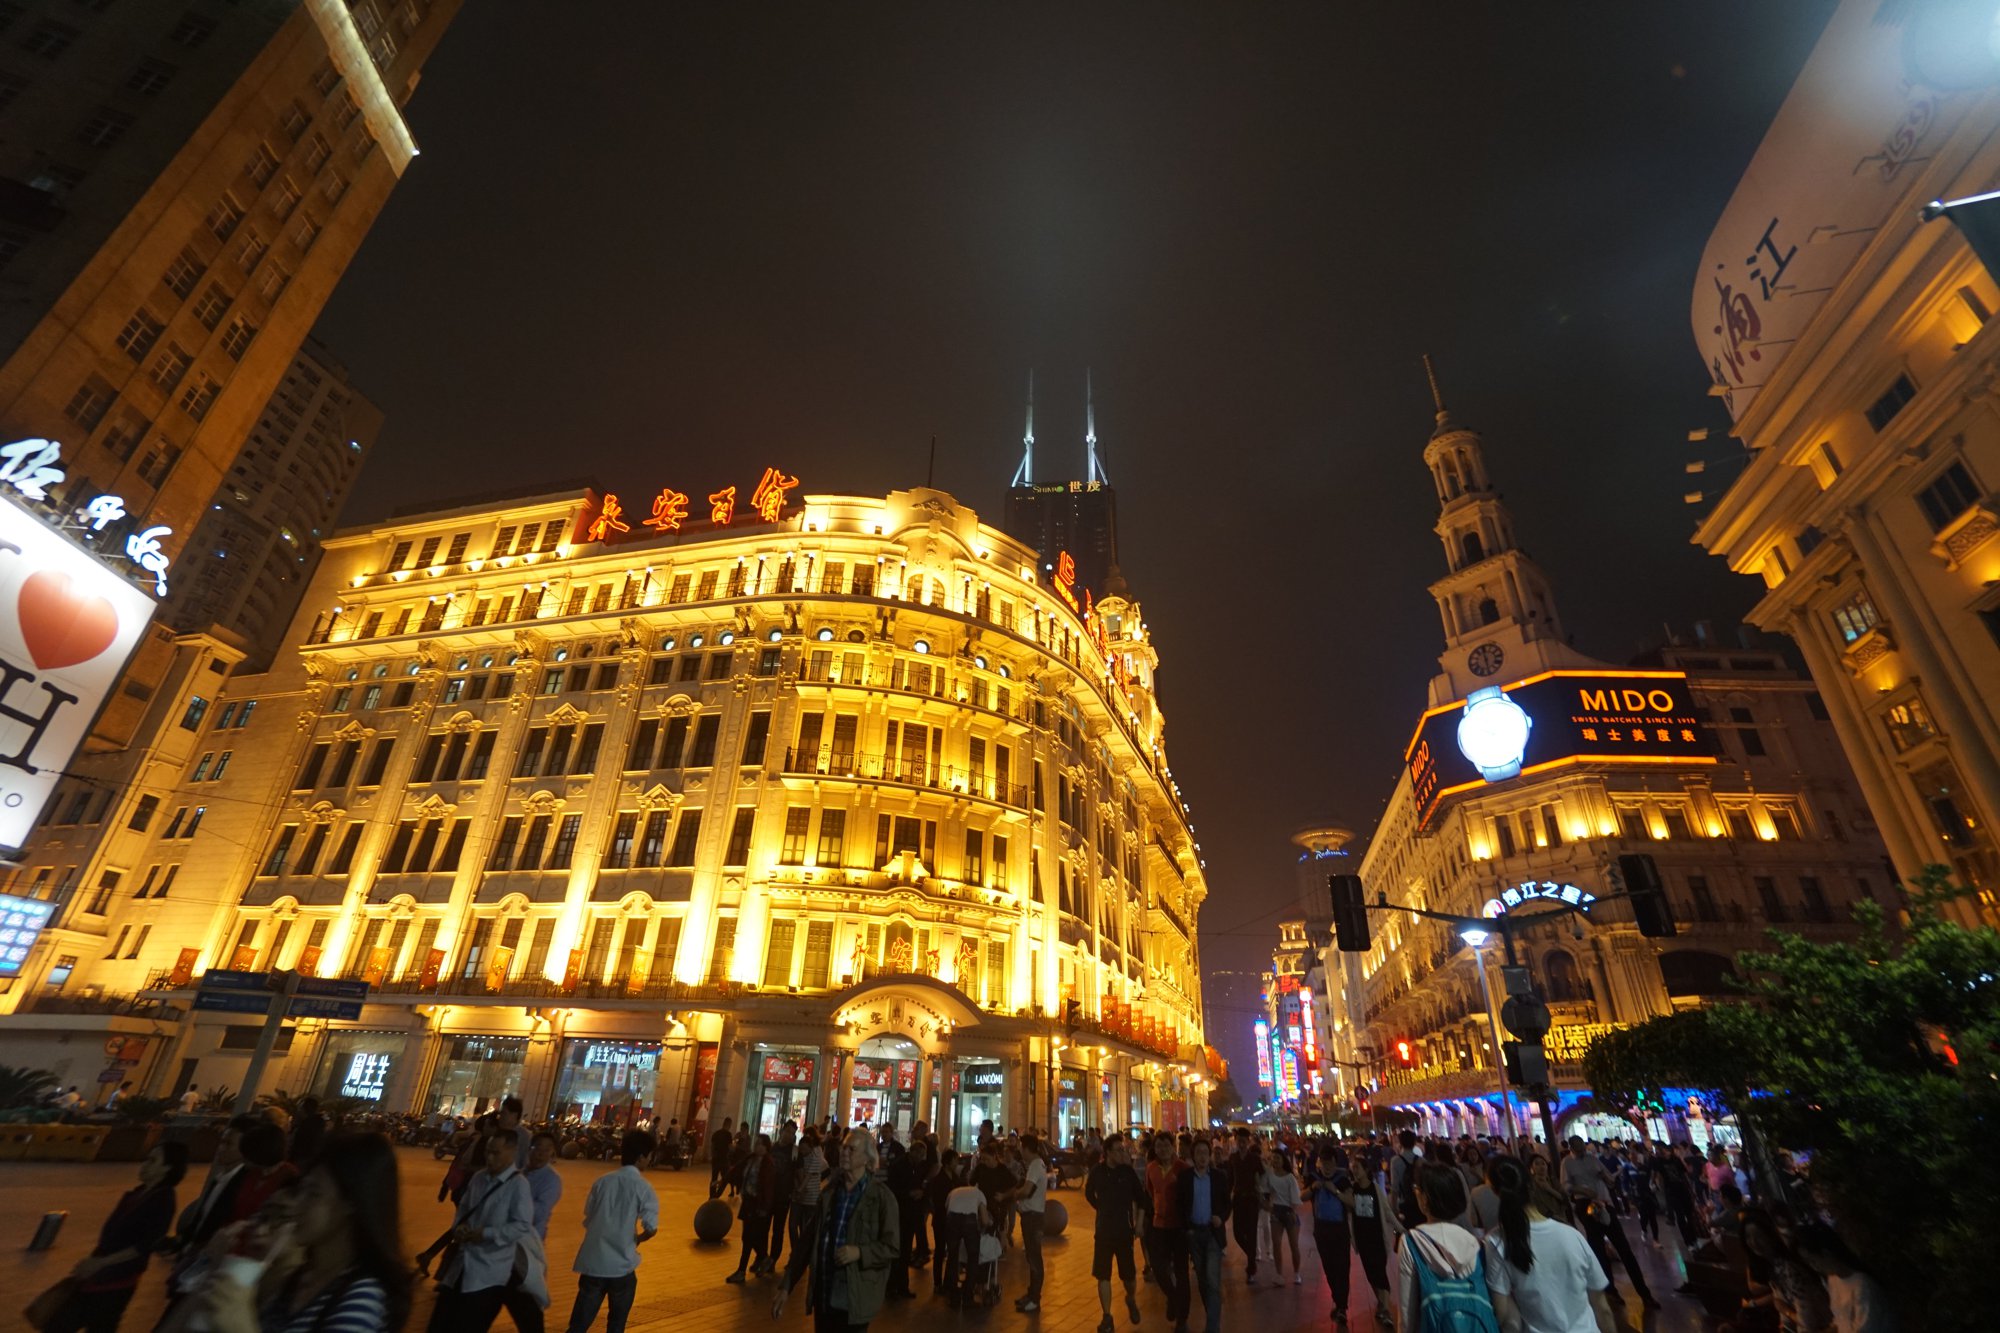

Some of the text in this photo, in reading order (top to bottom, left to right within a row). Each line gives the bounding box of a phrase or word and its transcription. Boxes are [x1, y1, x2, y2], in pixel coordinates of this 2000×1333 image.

[1069, 480, 1101, 493] 世茂
[1580, 689, 1674, 712] MIDO
[1582, 728, 1697, 742] 瑞士美度表
[1411, 740, 1429, 783] MIDO
[345, 1053, 390, 1087] 周生生
